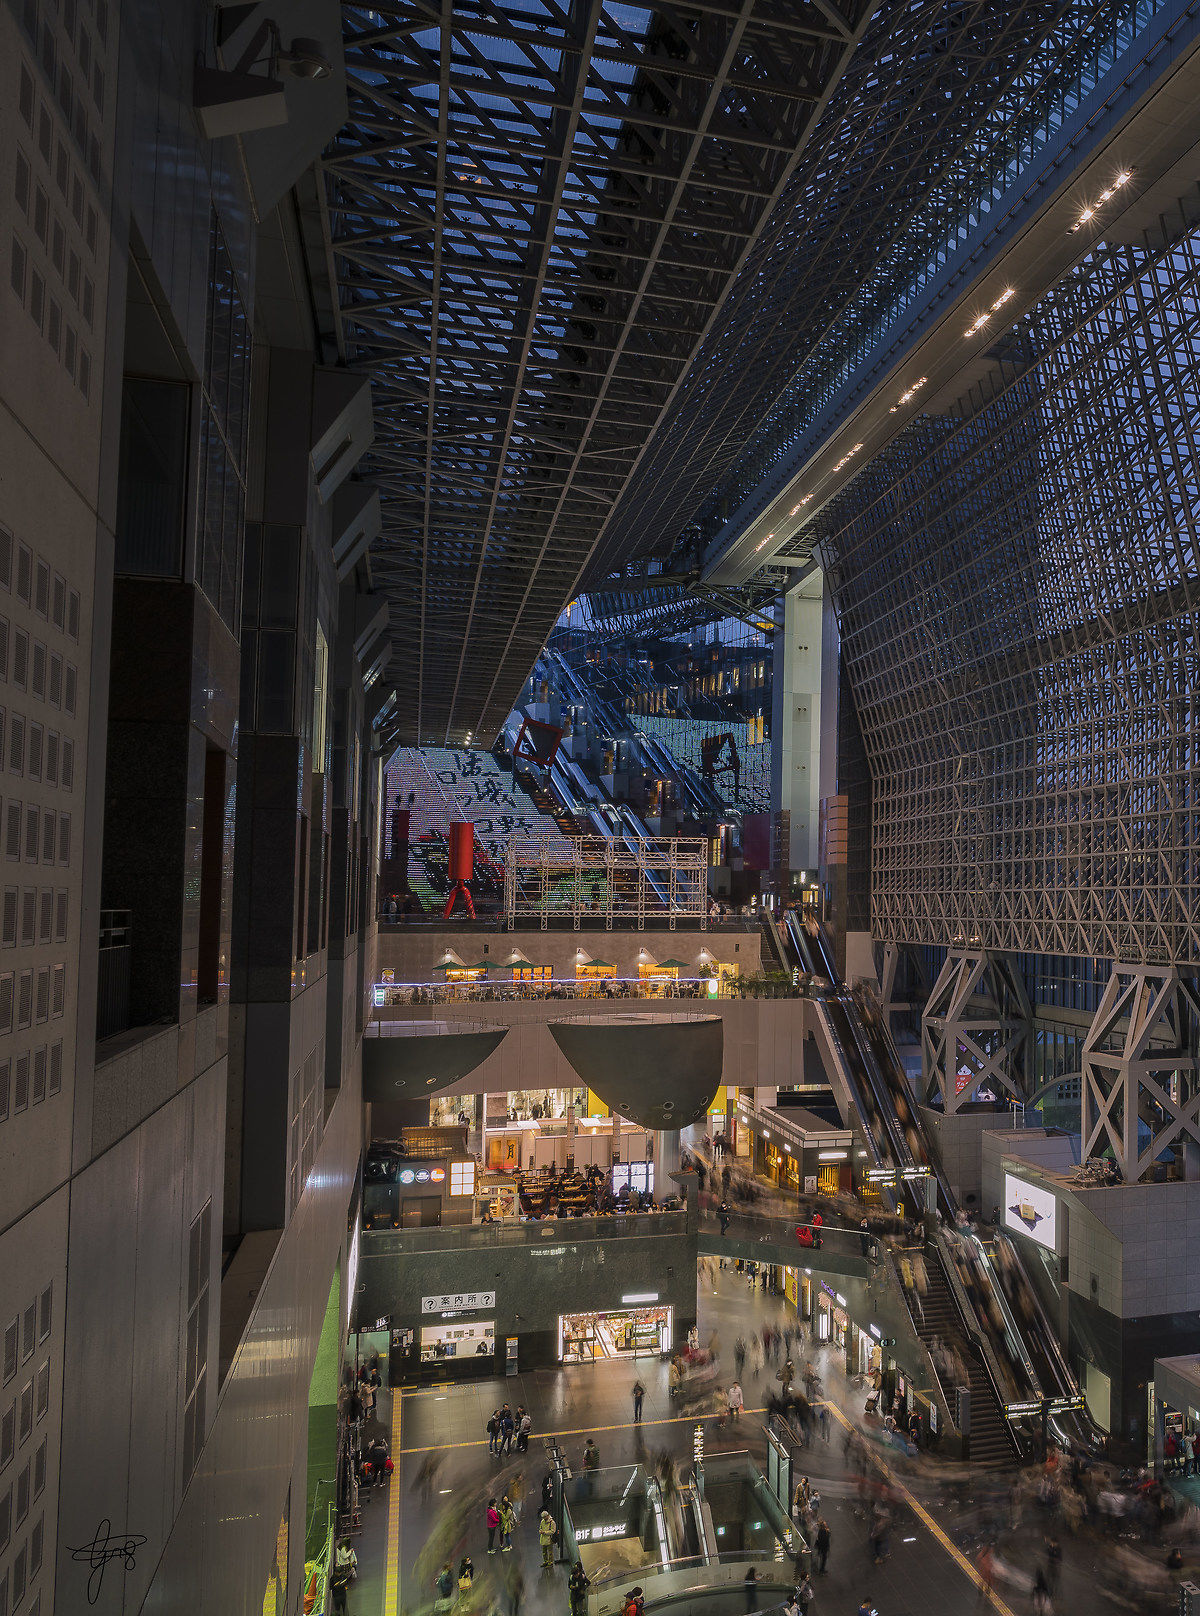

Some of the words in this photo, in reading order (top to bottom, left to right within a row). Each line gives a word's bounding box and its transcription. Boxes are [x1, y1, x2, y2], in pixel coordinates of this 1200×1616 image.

[441, 1294, 477, 1305] 案内所
[575, 1529, 590, 1541] B1F
